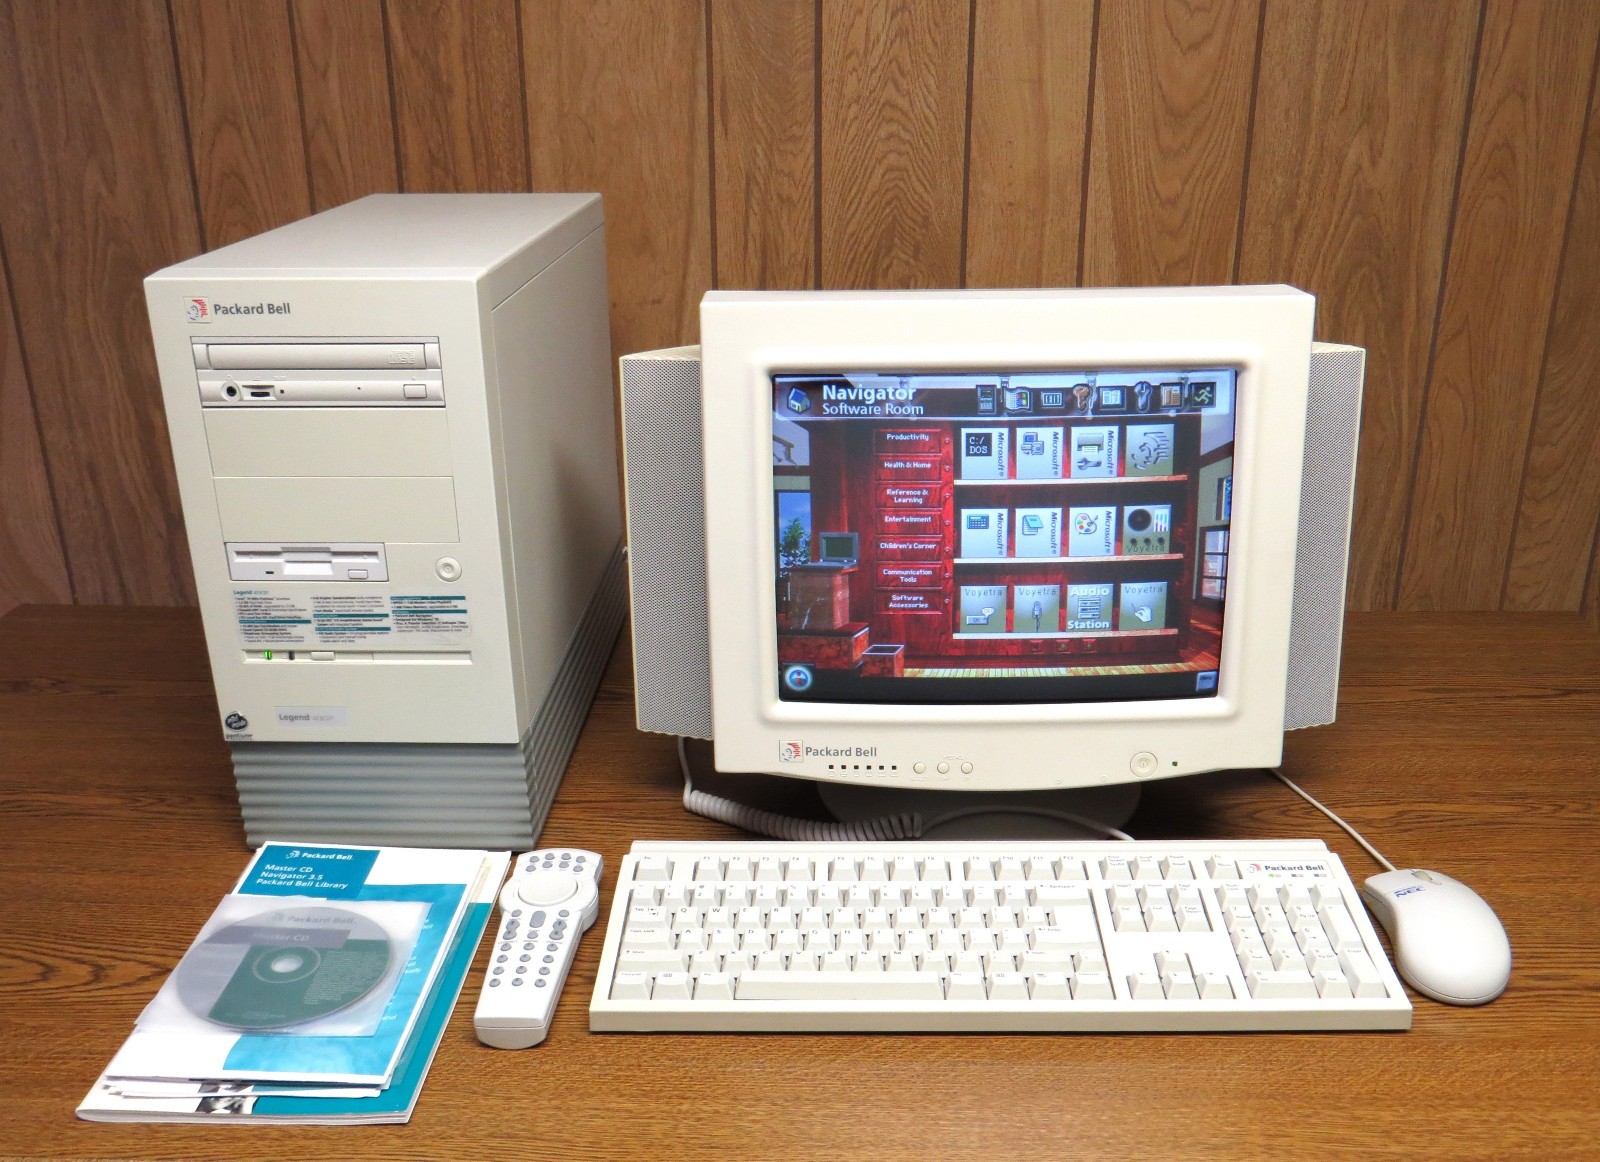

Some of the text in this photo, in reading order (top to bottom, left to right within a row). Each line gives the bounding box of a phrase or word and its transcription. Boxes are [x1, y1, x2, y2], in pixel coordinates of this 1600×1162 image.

[214, 303, 291, 315] Packard Bell
[823, 385, 917, 402] Navigator
[822, 402, 924, 415] Software Room
[886, 433, 929, 442] Productivity
[970, 446, 988, 454] DOS
[894, 496, 922, 504] Learning
[880, 542, 936, 550] Children's Corner
[883, 568, 932, 576] Communication
[964, 588, 1003, 598] Voyetra
[1018, 588, 1056, 598] Voyetra
[1070, 586, 1110, 596] Audio
[1124, 586, 1164, 596] Voyetra
[892, 594, 924, 602] Software
[1068, 620, 1110, 630] Station
[279, 713, 310, 722] Legend
[806, 746, 877, 756] Packard Bell
[264, 864, 296, 872] Master
[260, 872, 306, 880] Navigator
[314, 882, 348, 890] Library
[1394, 886, 1426, 898] NEC
